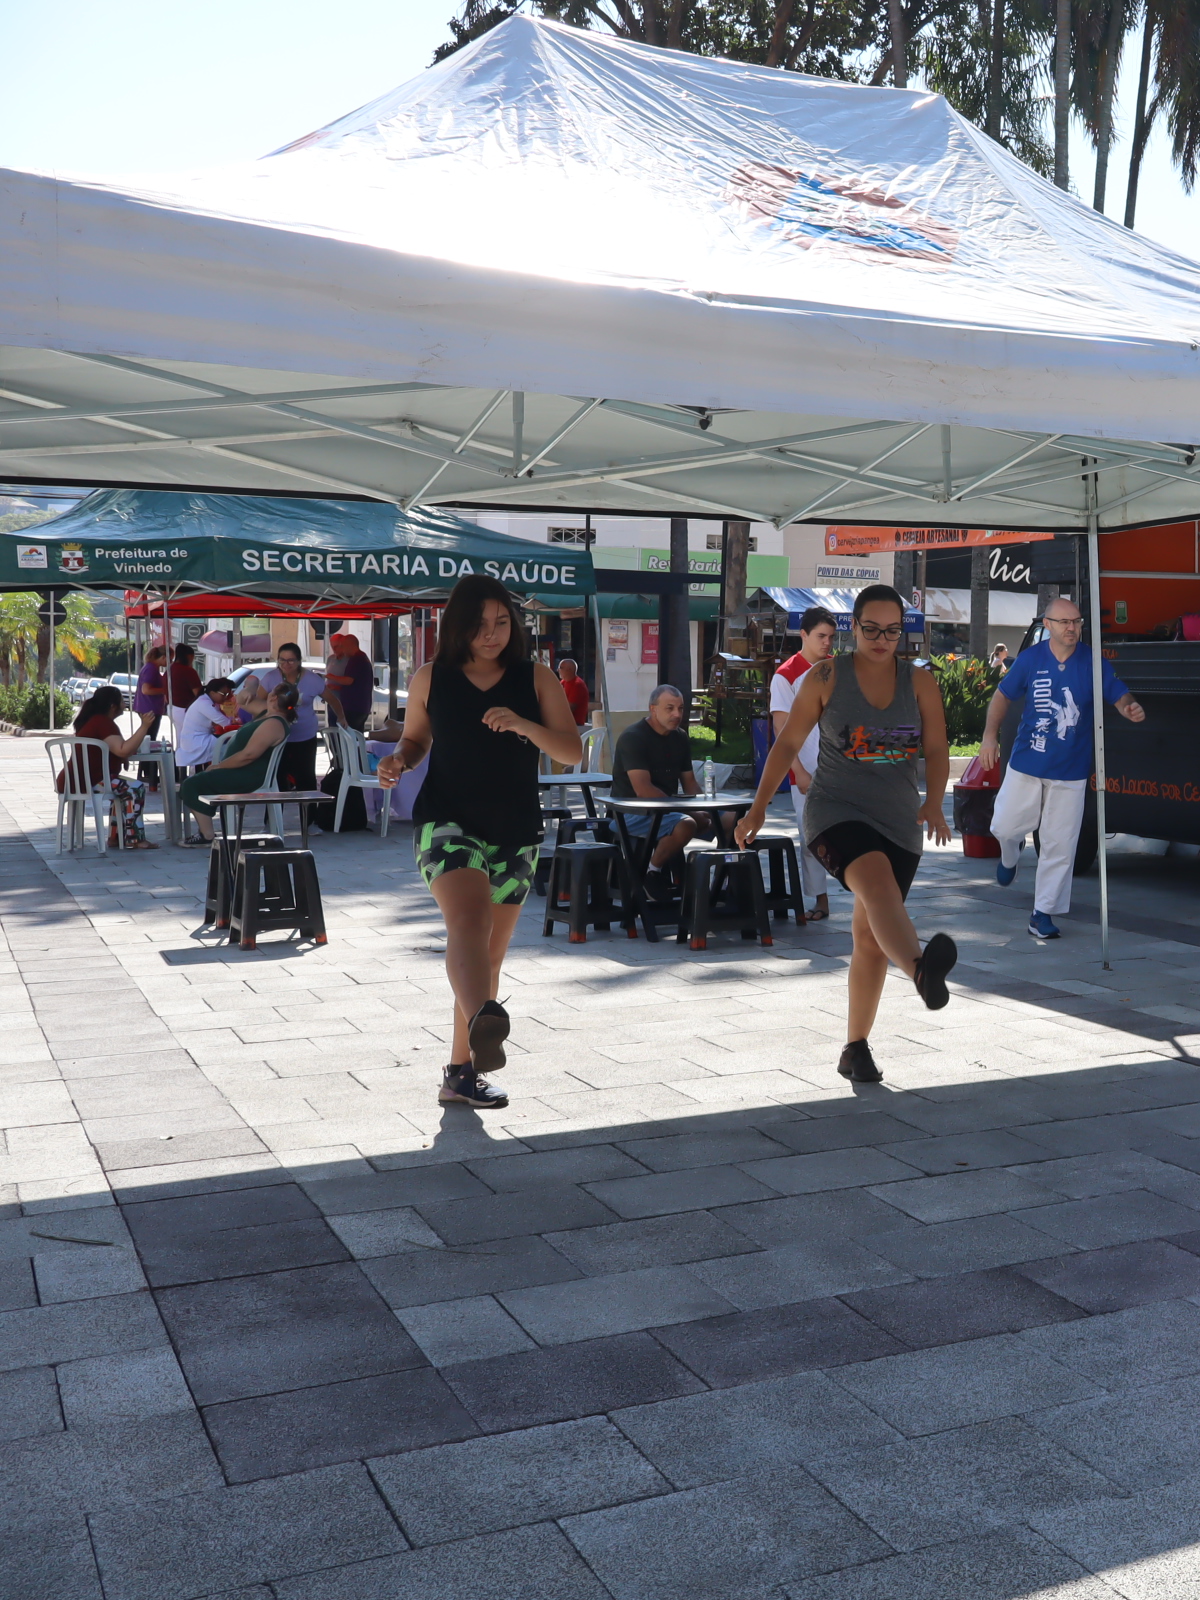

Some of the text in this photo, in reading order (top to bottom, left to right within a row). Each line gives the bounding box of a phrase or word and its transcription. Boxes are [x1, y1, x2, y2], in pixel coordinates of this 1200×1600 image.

[95, 548, 188, 560] Prefeitura de
[113, 562, 173, 574] Vinhedo
[242, 549, 577, 586] SECRETARIA DA SAÚDE
[817, 566, 880, 578] PONTO DAS CÓPIAS
[913, 593, 919, 605] E
[1032, 678, 1053, 715] JUDO
[1160, 783, 1182, 801] POR
